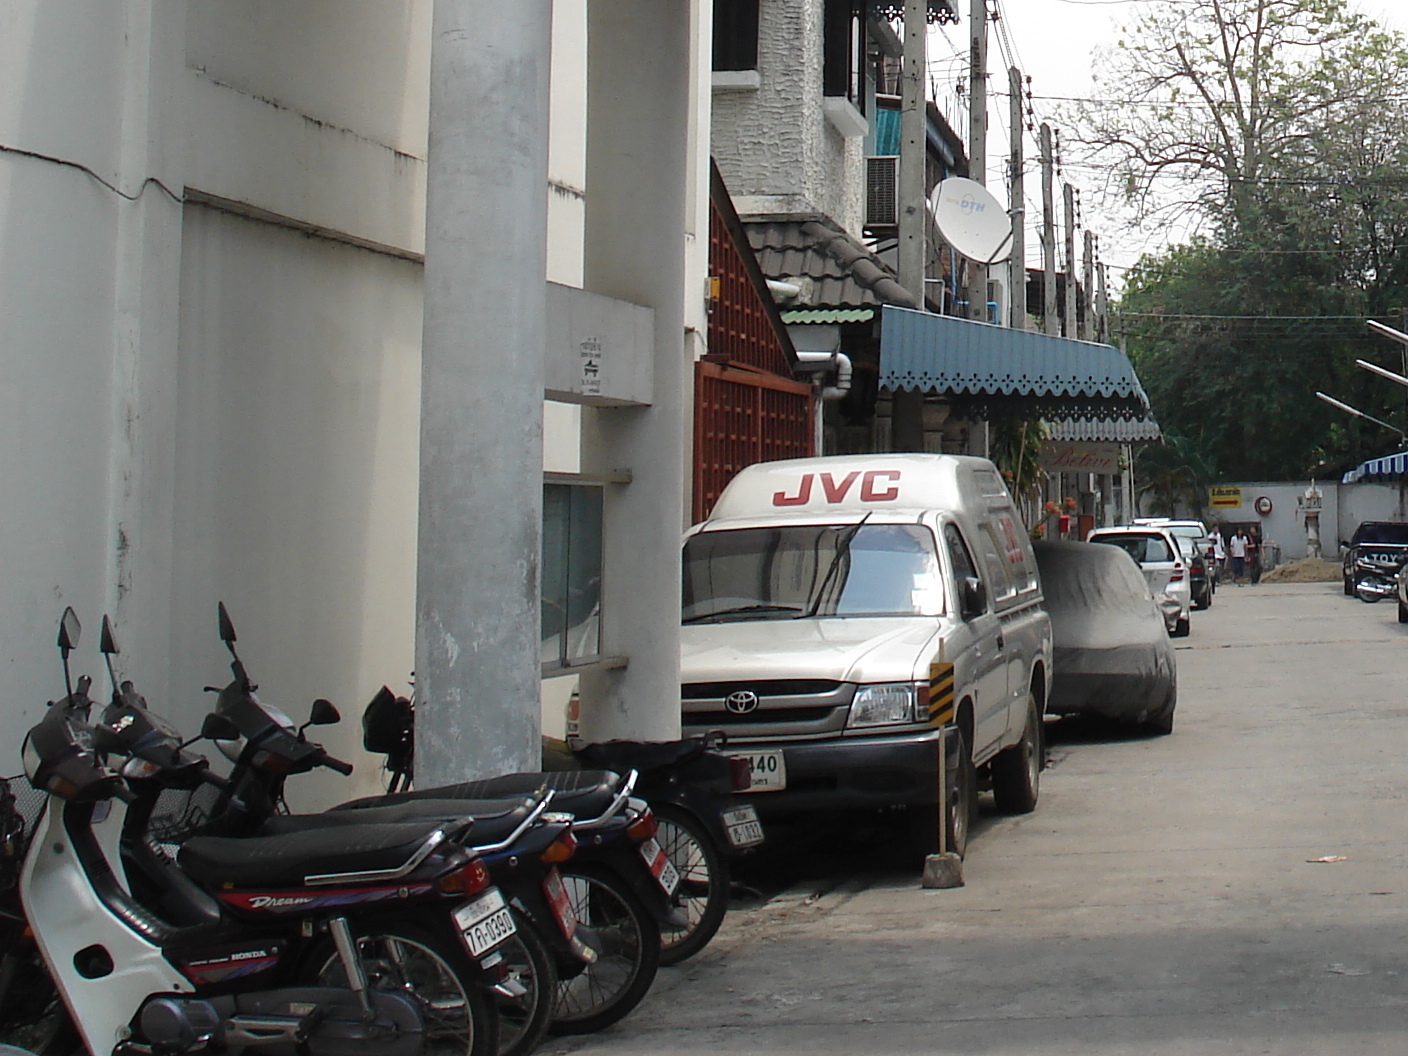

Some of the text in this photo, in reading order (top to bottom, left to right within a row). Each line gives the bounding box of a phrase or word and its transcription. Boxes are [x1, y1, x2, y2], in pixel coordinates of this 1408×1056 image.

[960, 200, 985, 212] DTH
[772, 470, 902, 507] JVC
[248, 896, 314, 908] Dream
[230, 950, 267, 961] HONDA
